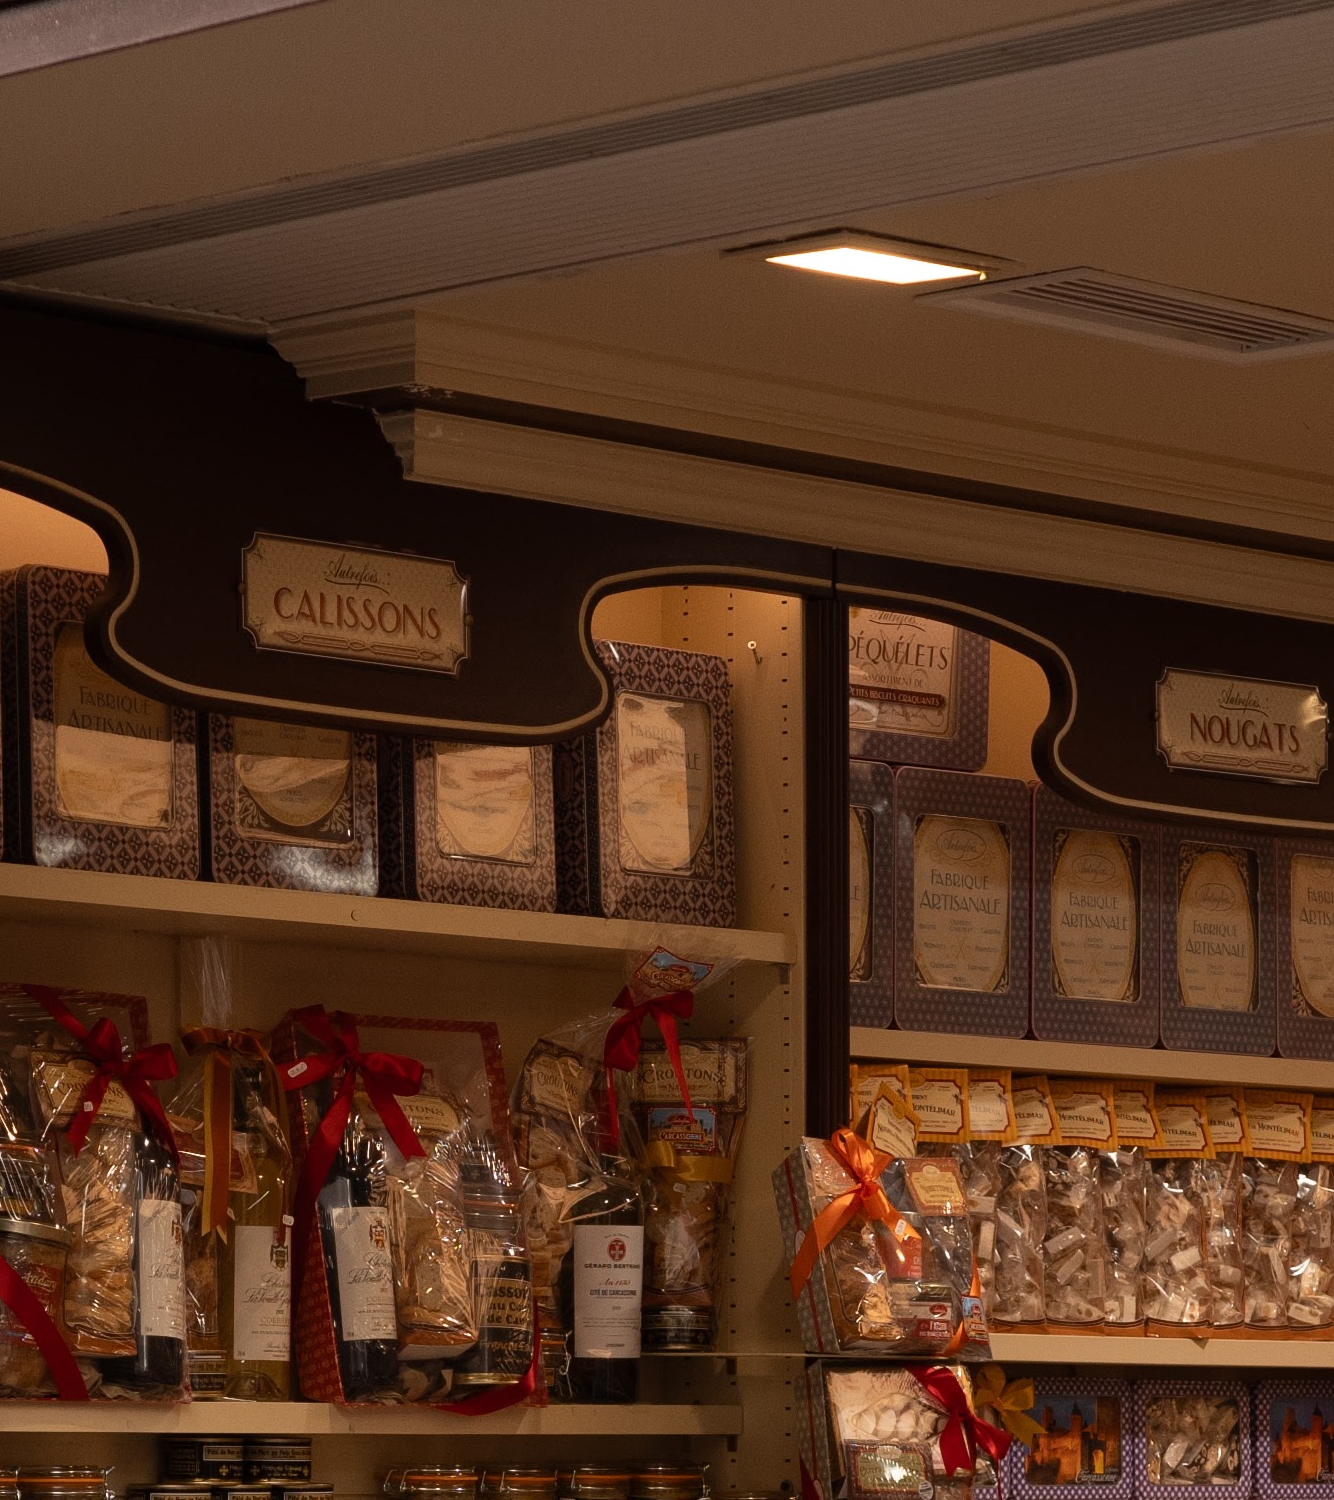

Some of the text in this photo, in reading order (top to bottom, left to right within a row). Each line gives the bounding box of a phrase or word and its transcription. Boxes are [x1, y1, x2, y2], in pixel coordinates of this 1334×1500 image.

[274, 587, 441, 640] CALISSONS
[915, 679, 923, 687] DE
[79, 685, 152, 715] FABRIQUE
[870, 692, 896, 700] BISCUITS
[898, 694, 939, 705] CRAQUANTS
[68, 709, 163, 739] ARTISANALE
[1190, 713, 1300, 754] NOUGATS
[930, 869, 989, 891] FABRIQUE
[920, 889, 1001, 914] ARTISANALE
[1069, 891, 1119, 910] FABRIQUE
[1061, 910, 1128, 931] ARTISANALE
[1193, 920, 1237, 939] FABRIQUE
[1186, 938, 1247, 958] ARTISANALE
